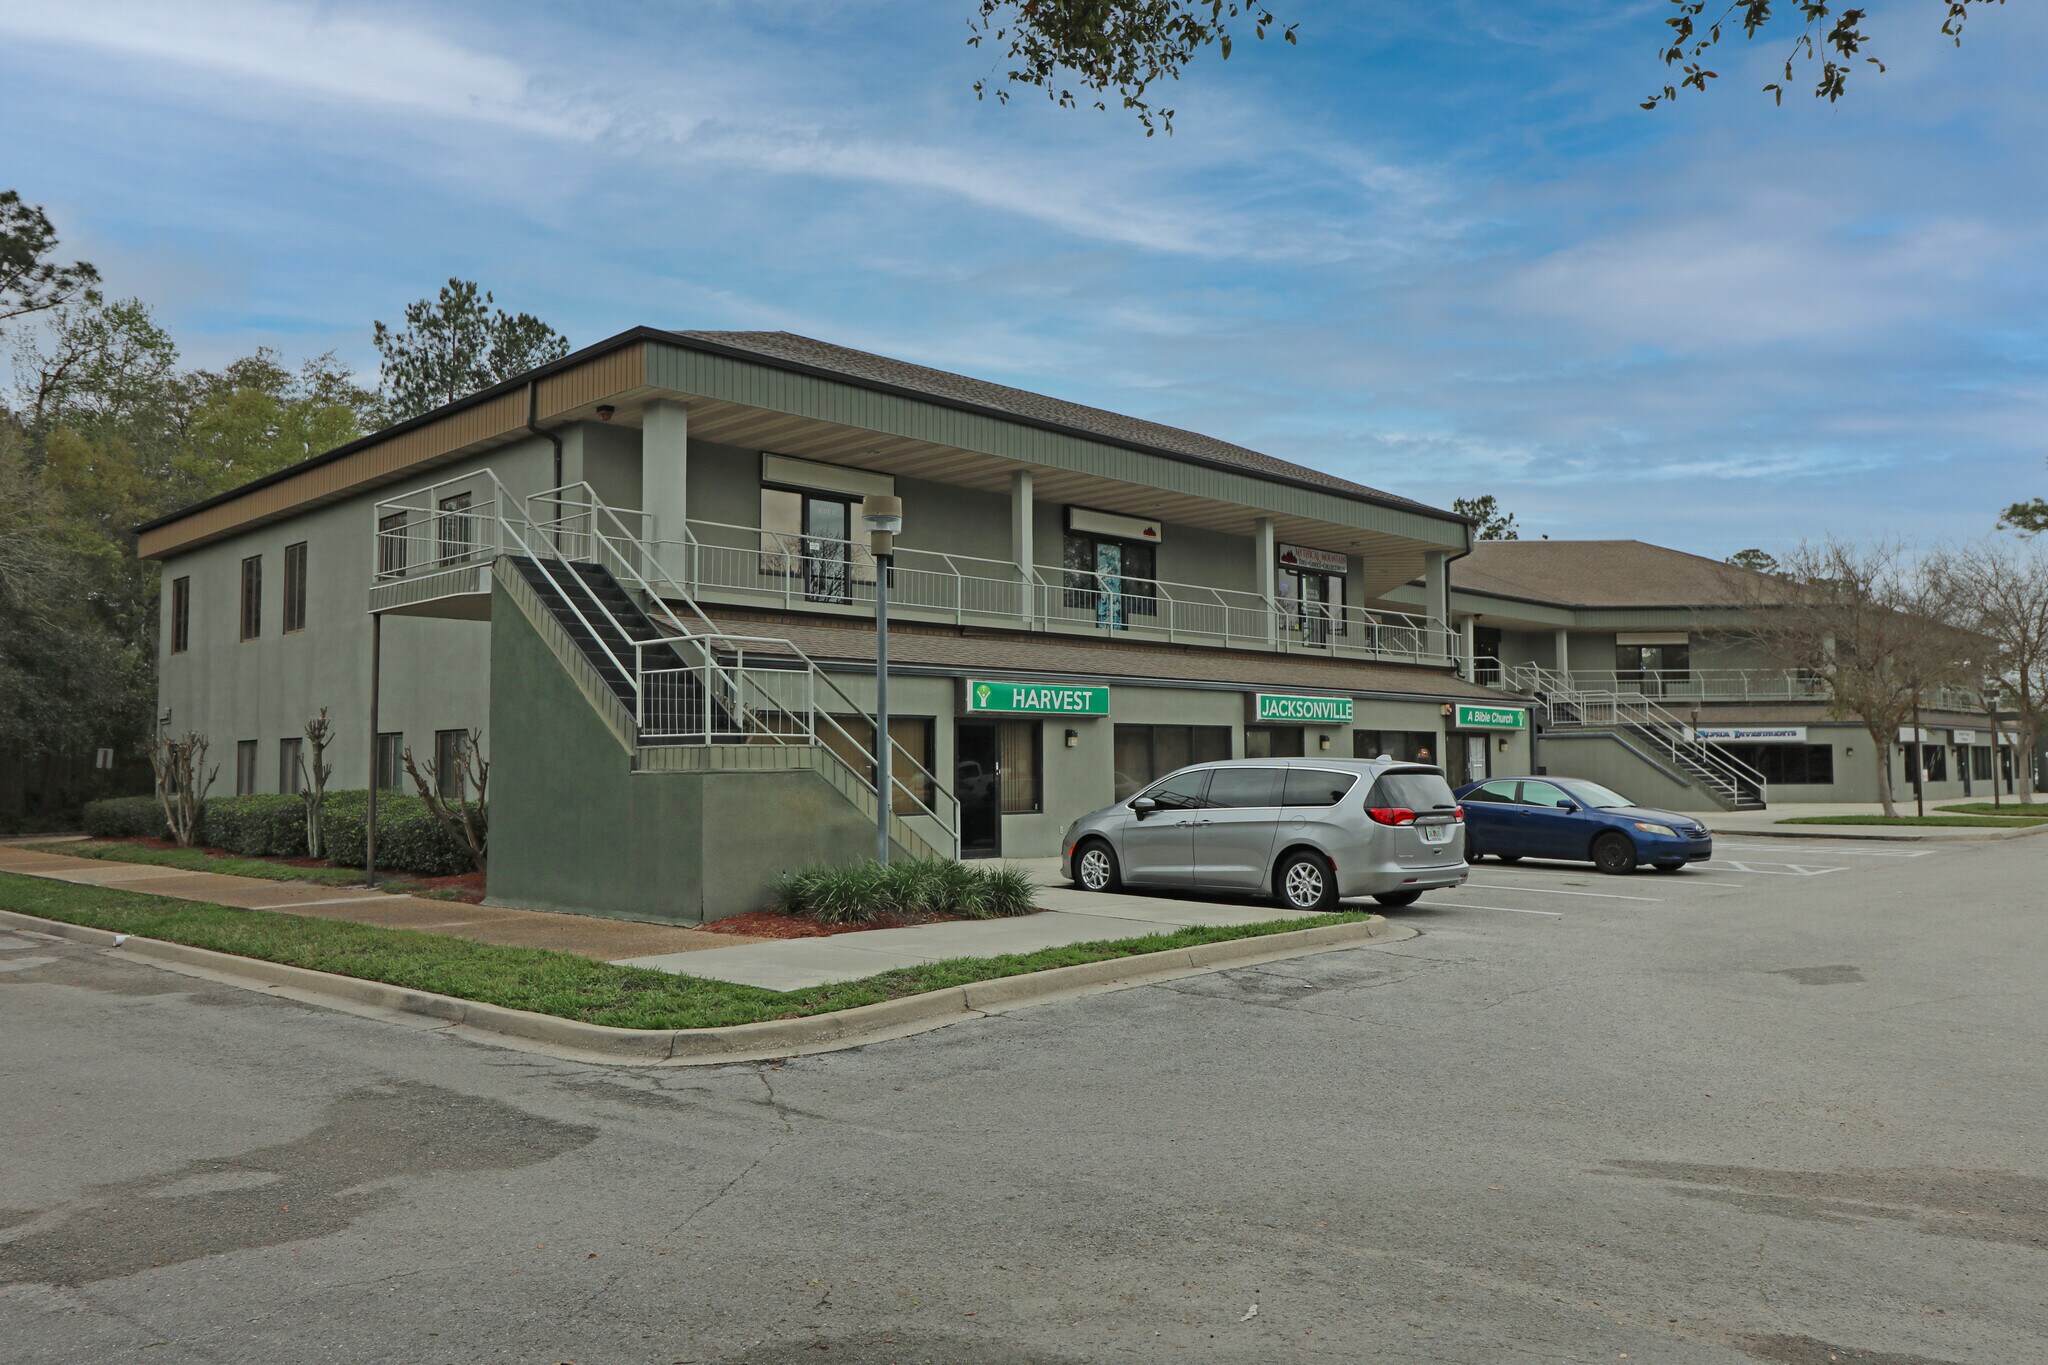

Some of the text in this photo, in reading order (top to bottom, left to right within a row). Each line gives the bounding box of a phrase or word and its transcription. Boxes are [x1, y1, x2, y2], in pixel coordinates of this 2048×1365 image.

[1012, 688, 1092, 710] HARVEST
[1262, 699, 1353, 719] JACKSONVILLE
[1467, 710, 1514, 724] A Bible Church
